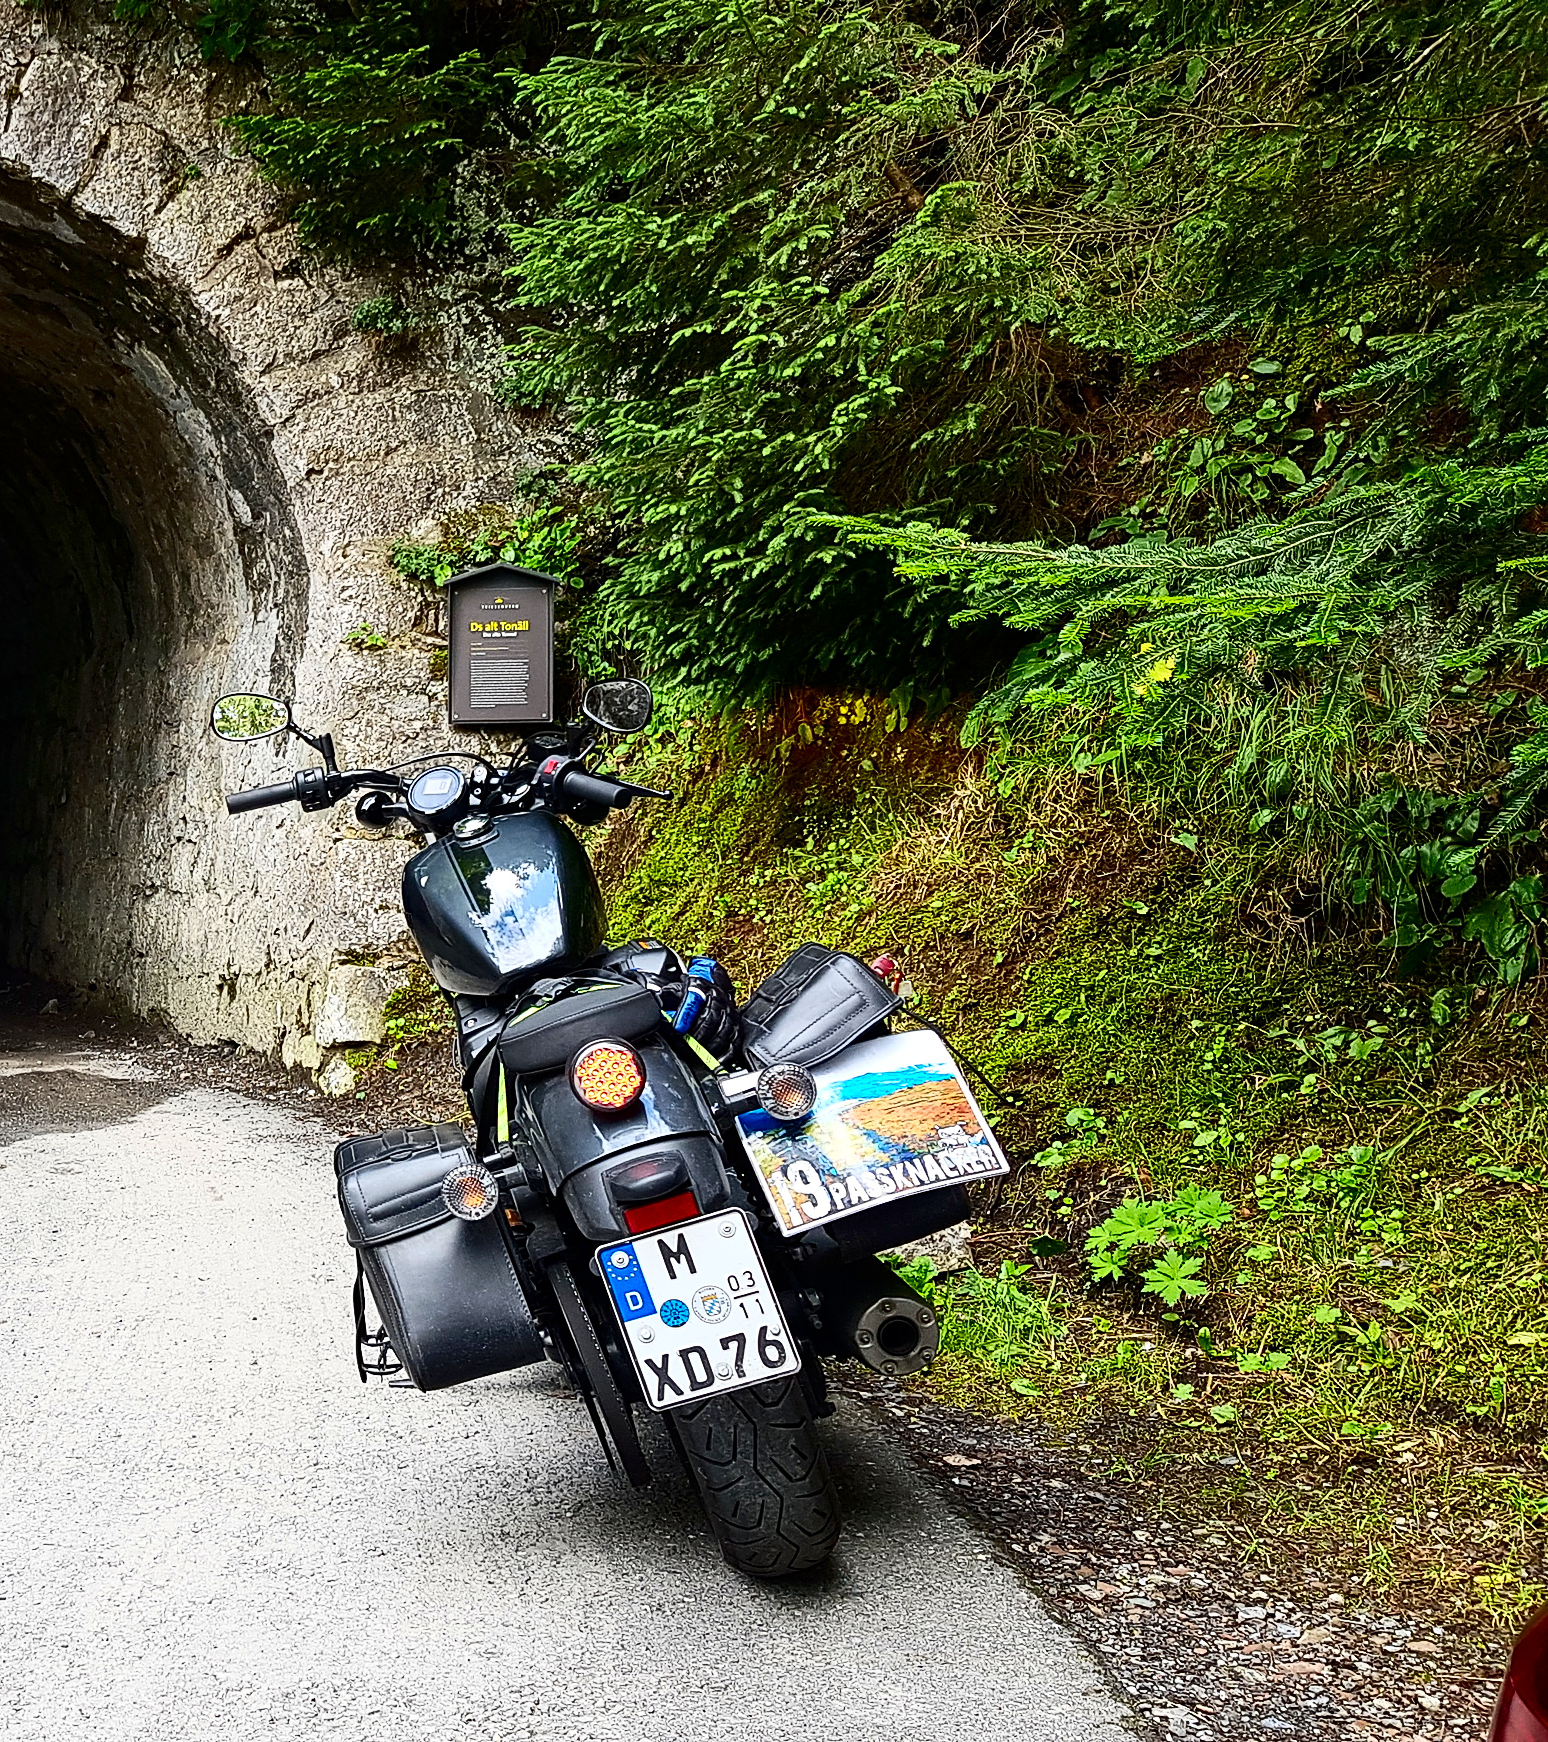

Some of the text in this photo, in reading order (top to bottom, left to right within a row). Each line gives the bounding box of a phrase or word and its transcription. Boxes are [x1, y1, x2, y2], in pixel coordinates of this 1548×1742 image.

[485, 621, 498, 631] alt
[769, 1144, 999, 1227] 19 PASSKNACKER
[657, 1233, 697, 1280] M
[727, 1271, 755, 1292] 03
[625, 1291, 644, 1311] D
[739, 1298, 765, 1319] 11
